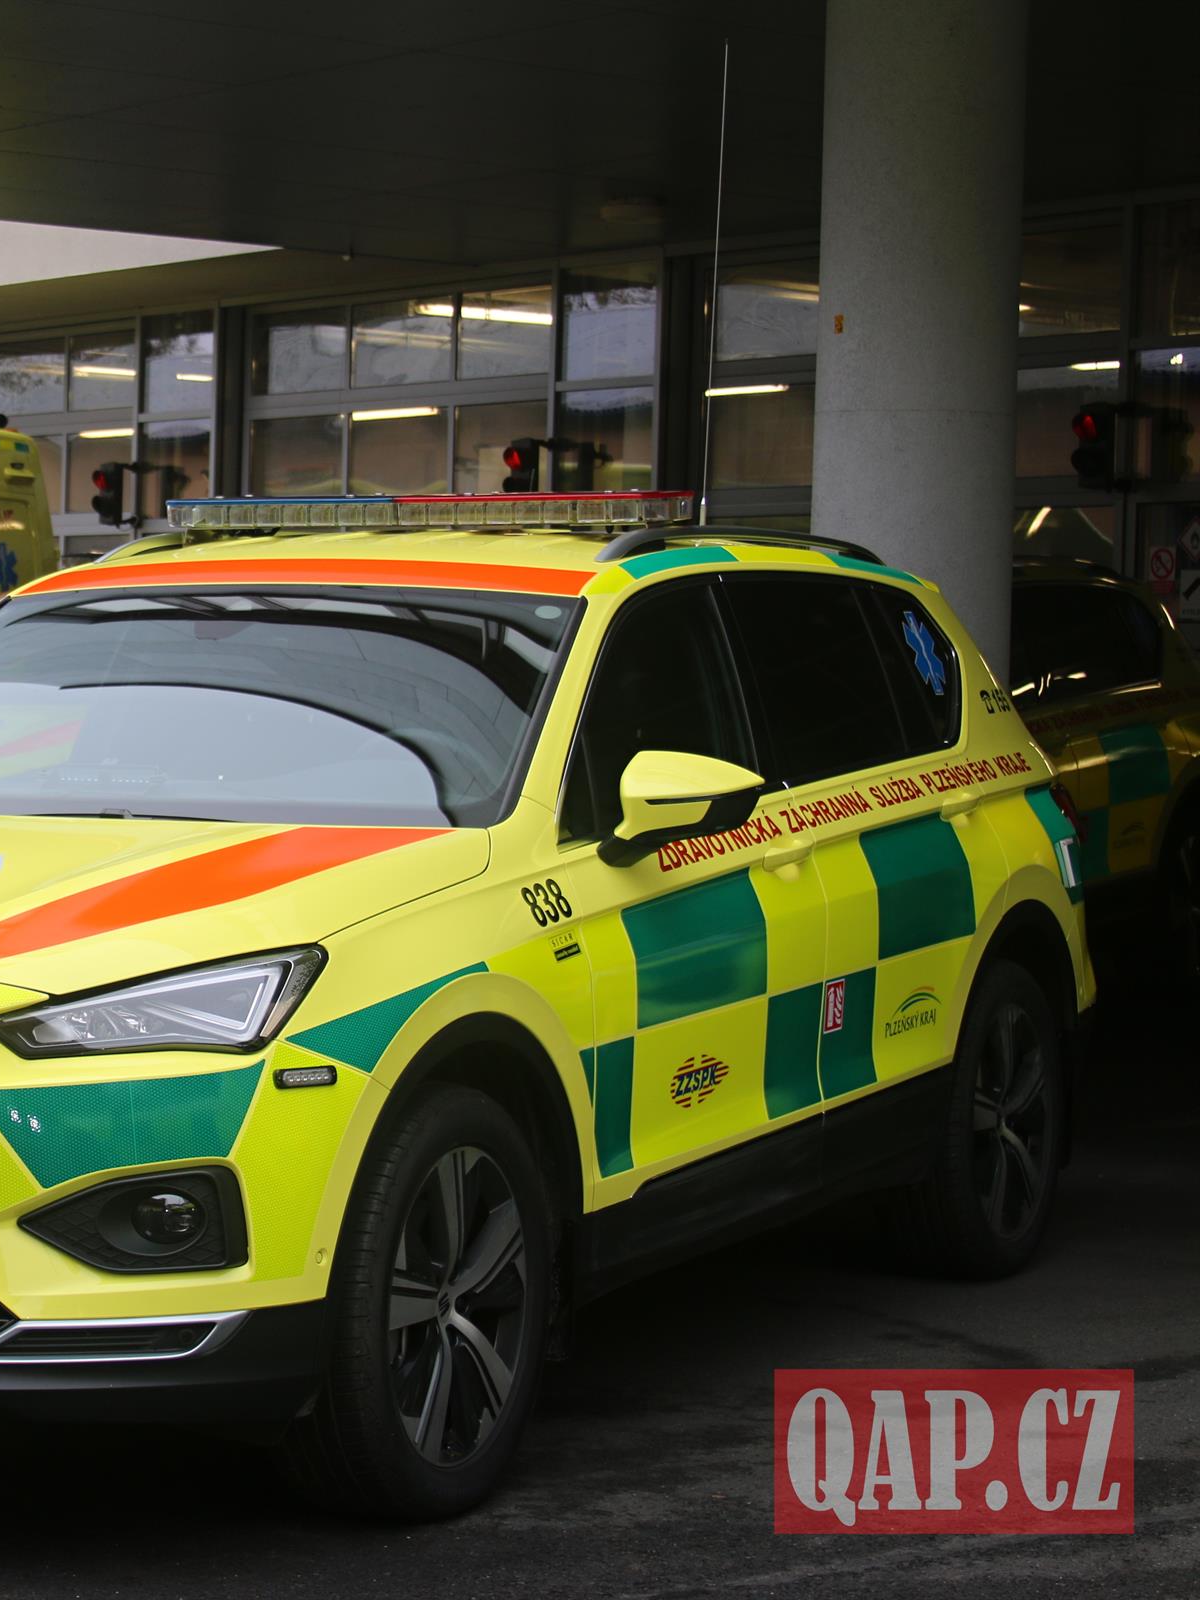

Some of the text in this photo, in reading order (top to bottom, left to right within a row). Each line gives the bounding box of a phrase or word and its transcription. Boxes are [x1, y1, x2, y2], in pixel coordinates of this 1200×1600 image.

[657, 752, 1032, 873] ZDRAVOTNICKÁ ZÁCHRANNÁ SLUŽBA PLZEŇSKÉHO KRAJE
[520, 878, 572, 927] 838
[920, 1008, 937, 1026] KRAJ
[675, 1065, 718, 1096] ZZSPK
